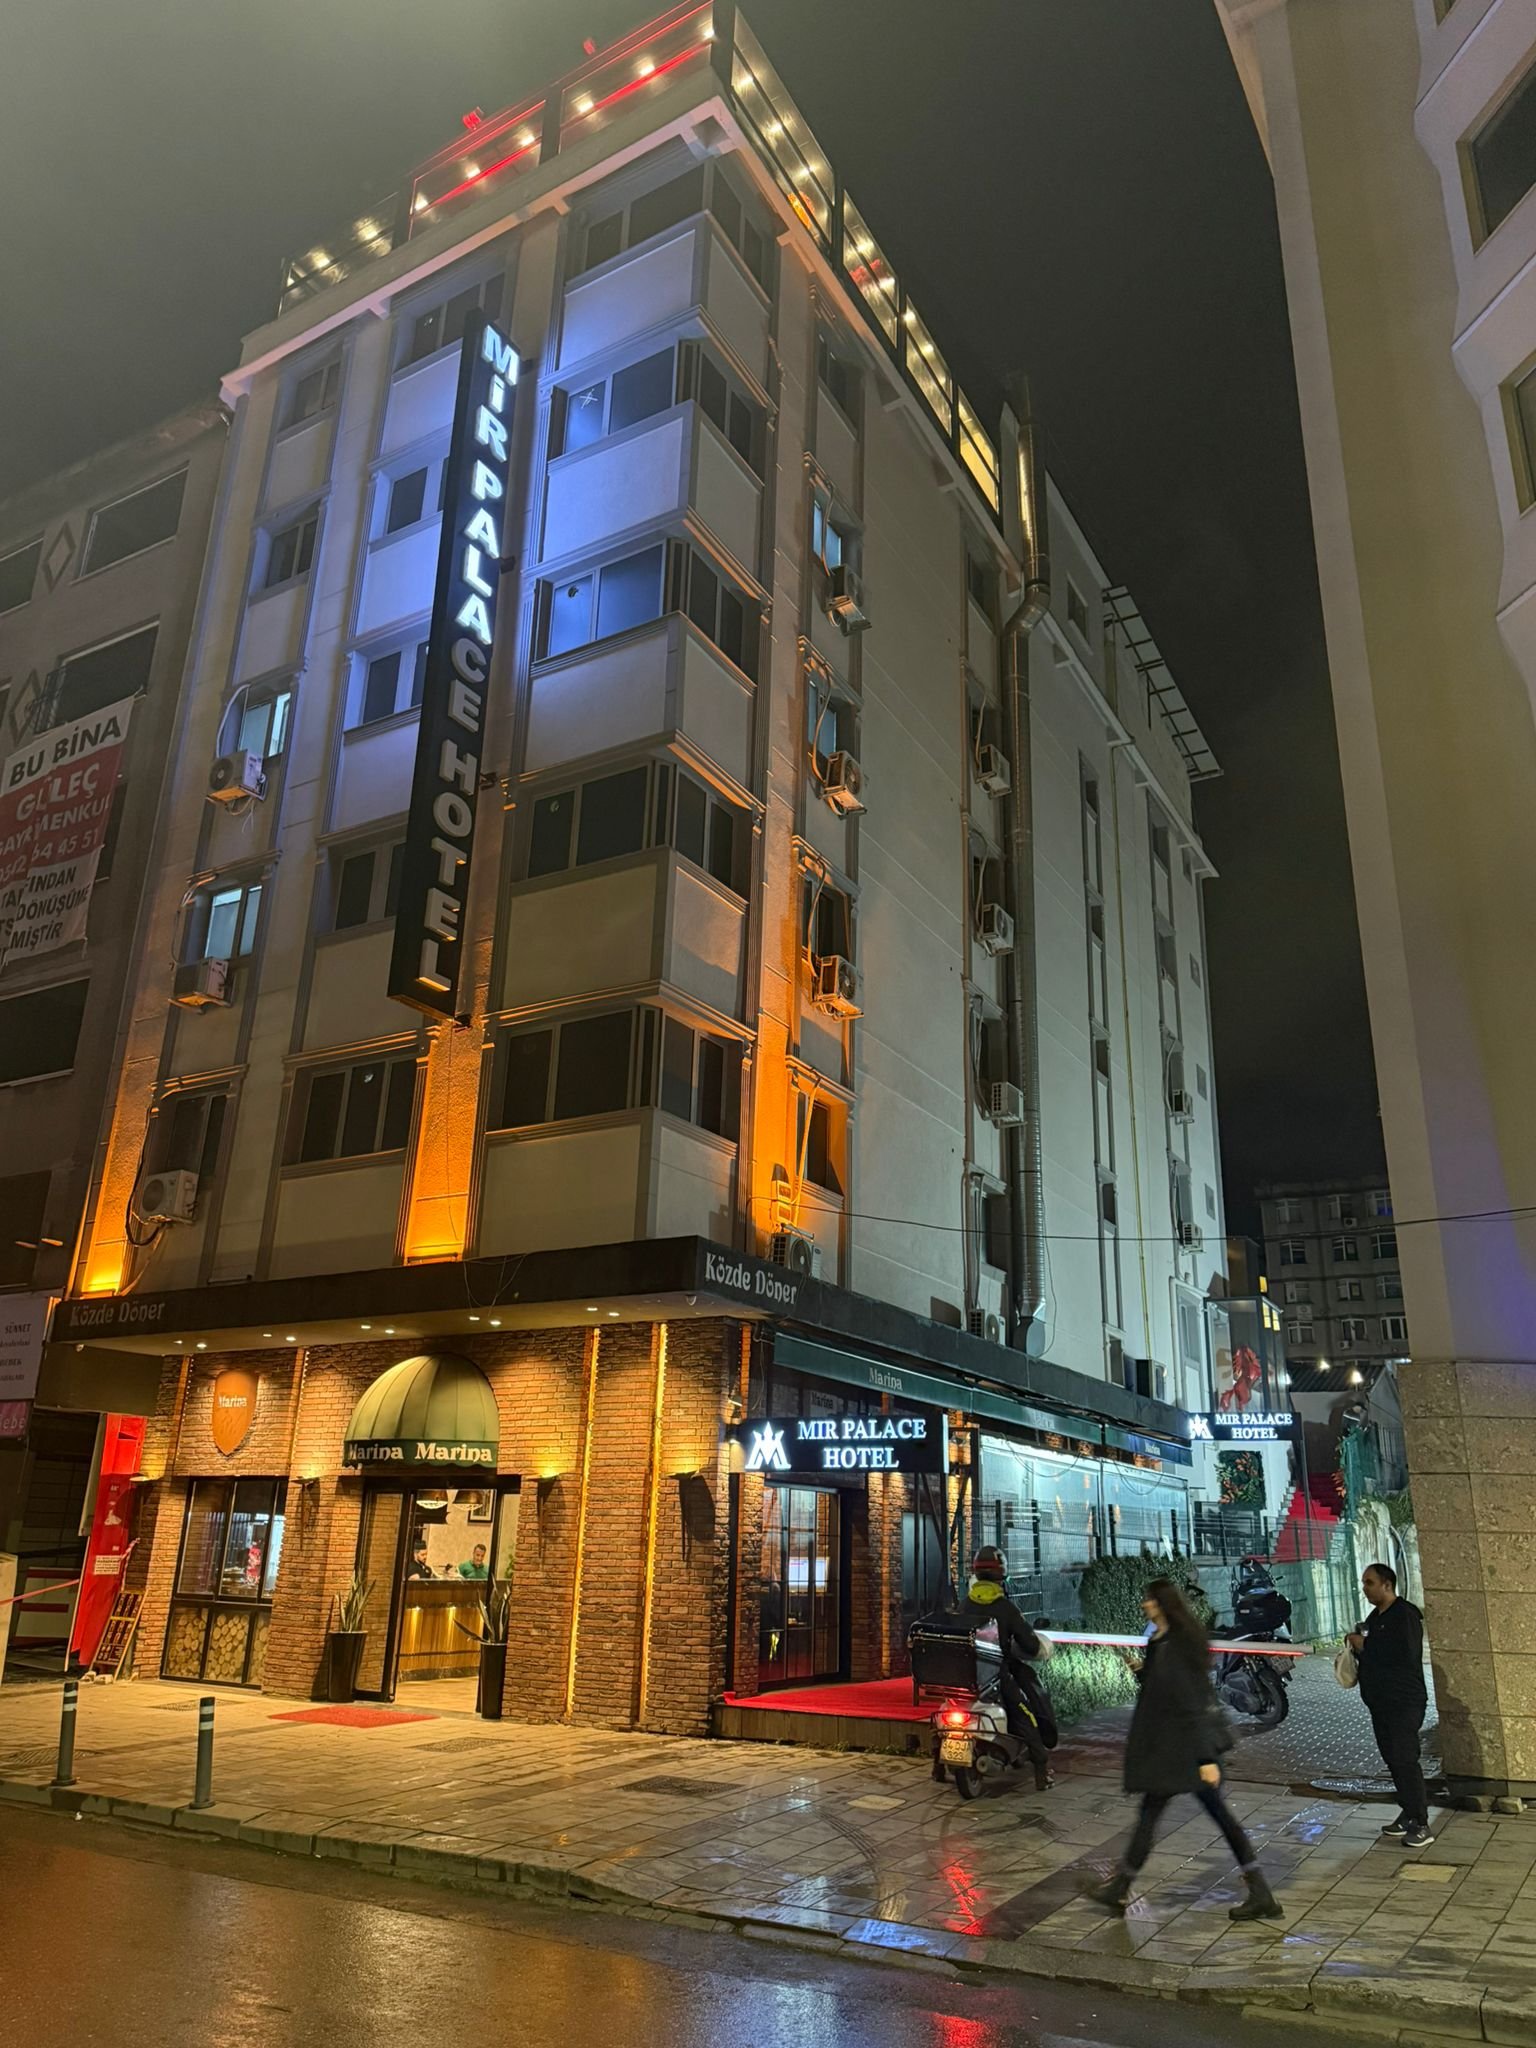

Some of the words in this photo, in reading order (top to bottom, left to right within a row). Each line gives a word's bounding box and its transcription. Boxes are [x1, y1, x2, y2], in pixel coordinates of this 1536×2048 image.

[10, 751, 44, 787] BU
[53, 717, 121, 762] BİNA
[418, 738, 478, 993] HOTEL
[705, 1252, 751, 1291] Közde
[755, 1270, 798, 1305] Döner
[70, 1304, 114, 1327] Közde
[118, 1301, 165, 1323] Döner
[869, 1367, 903, 1392] Marina
[218, 1394, 248, 1409] Marina
[797, 1420, 839, 1440] MIR
[842, 1418, 927, 1440] PALACE
[1215, 1413, 1240, 1425] MIR
[1242, 1413, 1293, 1425] PALACE
[1231, 1427, 1278, 1440] HOTEL
[348, 1443, 404, 1462] Marina
[414, 1442, 493, 1463] Marina
[822, 1447, 900, 1469] HOTEL
